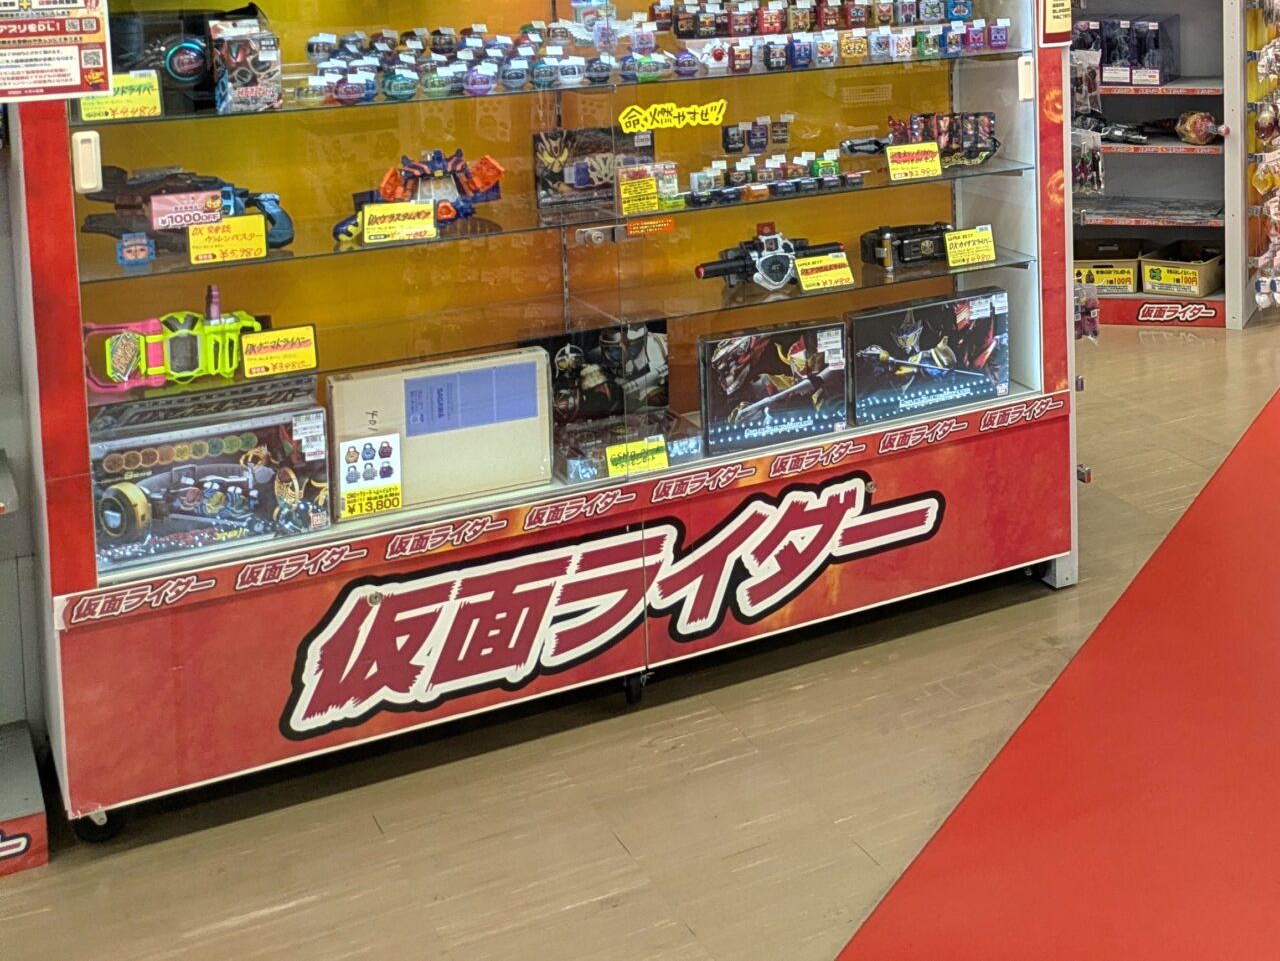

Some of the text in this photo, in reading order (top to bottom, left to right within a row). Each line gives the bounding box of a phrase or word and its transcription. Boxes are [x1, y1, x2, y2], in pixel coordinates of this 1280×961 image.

[1139, 303, 1216, 323] 仮面ライダー
[980, 397, 1065, 431] 仮面ライダー
[879, 418, 968, 453] 仮面ライダー
[770, 441, 866, 478] 仮面ライダー
[651, 466, 756, 503] 仮面ライダー
[347, 497, 401, 516] ¥13,800
[523, 488, 636, 530] 仮面ライダー
[387, 517, 508, 558] 仮面ライダー
[235, 544, 368, 590] 仮面ライダー
[72, 575, 216, 622] 仮面ライダー
[292, 482, 936, 732] 仮面ライダー
